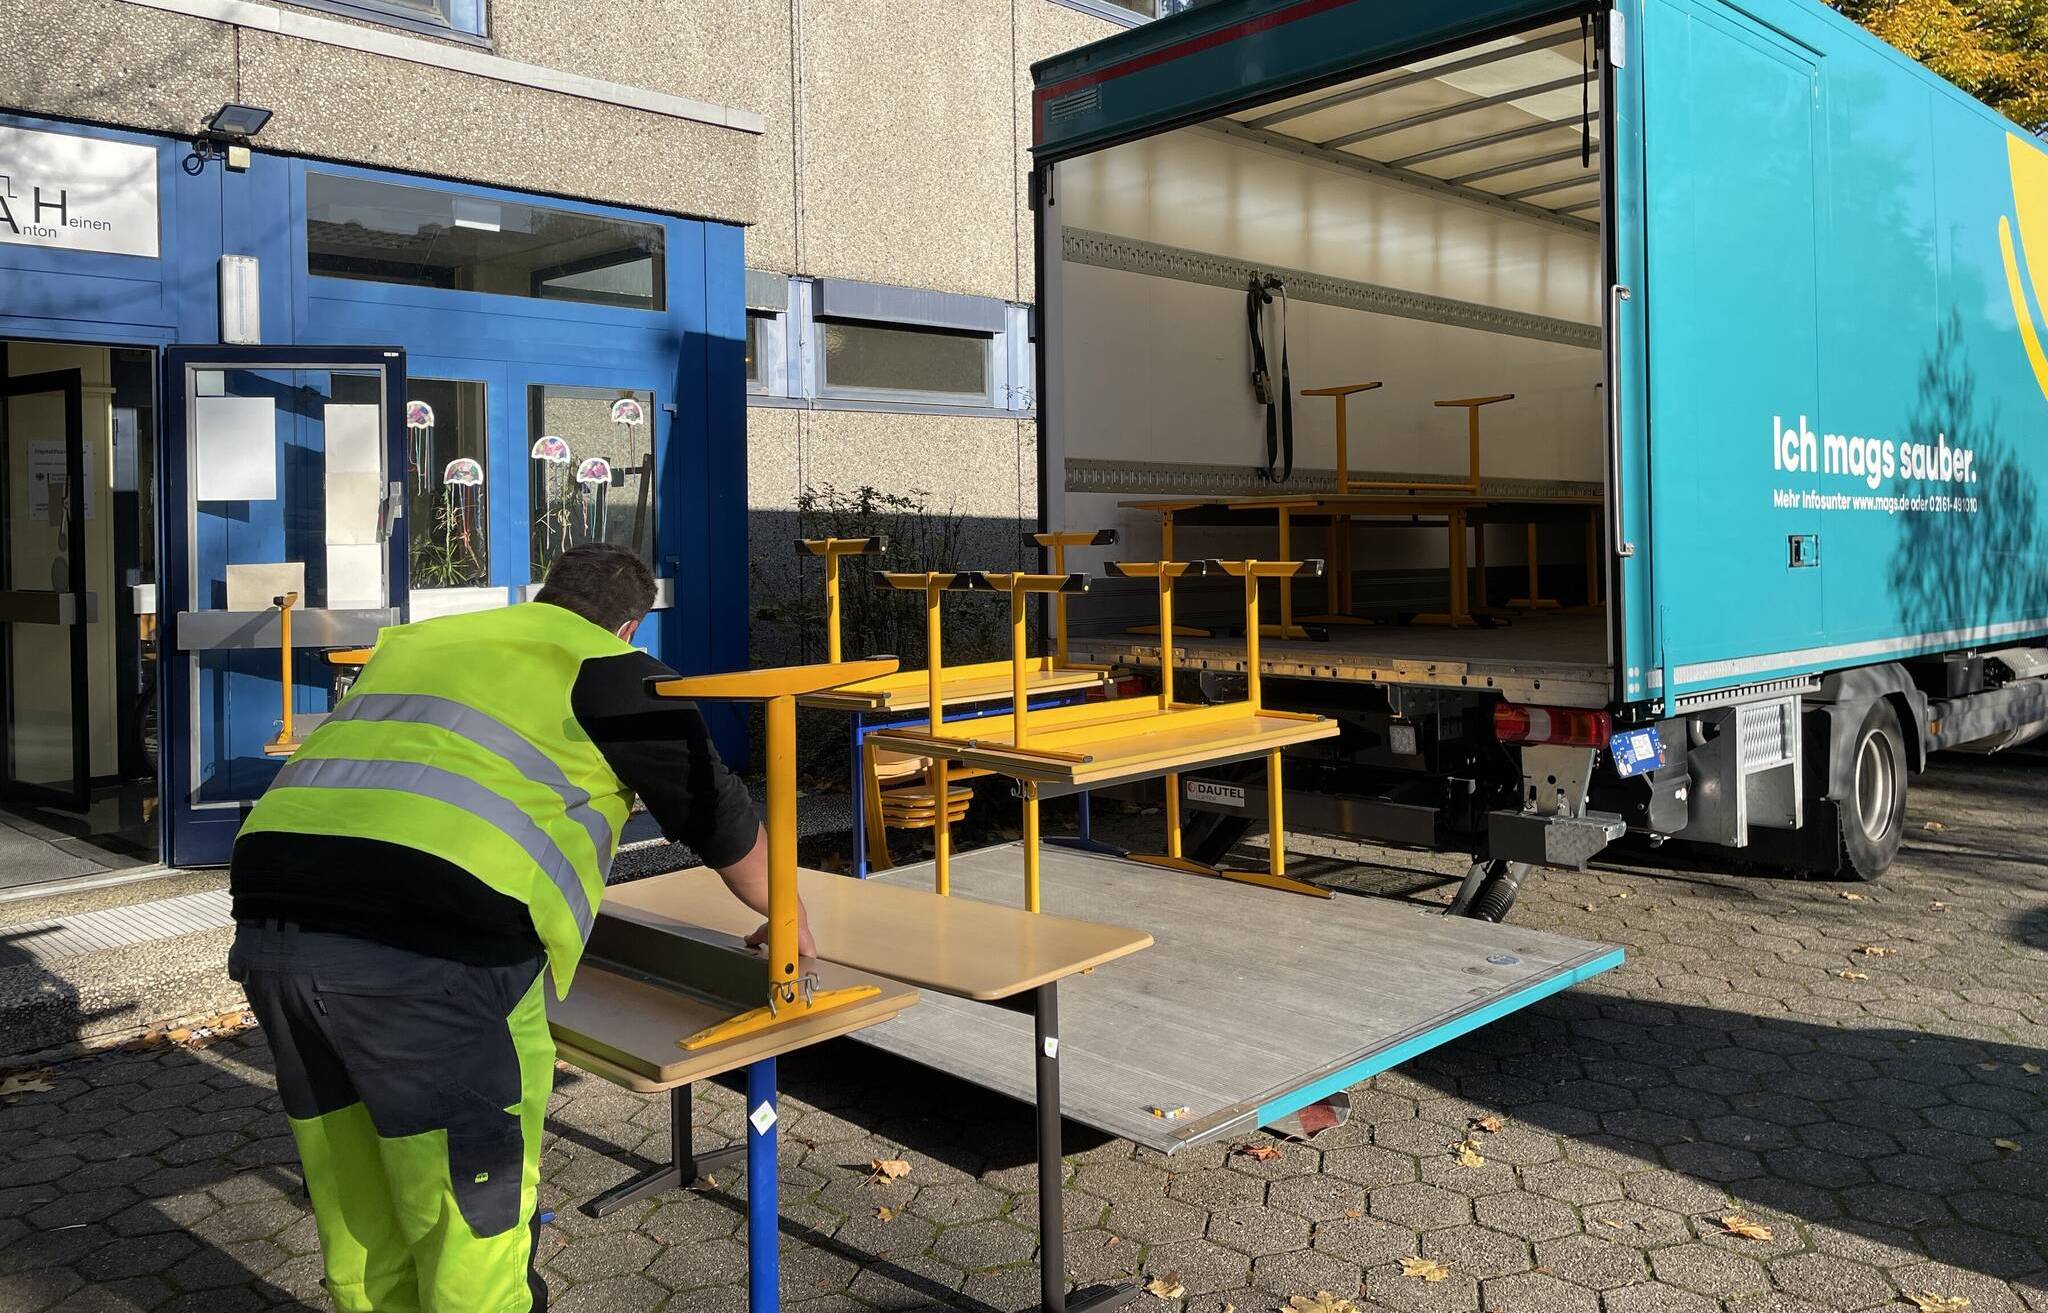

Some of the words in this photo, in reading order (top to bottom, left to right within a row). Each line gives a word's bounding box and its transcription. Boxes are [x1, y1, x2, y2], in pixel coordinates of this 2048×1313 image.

[34, 186, 112, 232] Heinen
[1773, 415, 1818, 472] Ich
[1823, 433, 1895, 489] mags
[1899, 433, 1977, 483] sauber.
[1773, 489, 1800, 508] Mehr
[1852, 495, 1910, 514] www.mags.de
[1910, 495, 1929, 512] oder
[1198, 784, 1244, 798] DAUTEL
